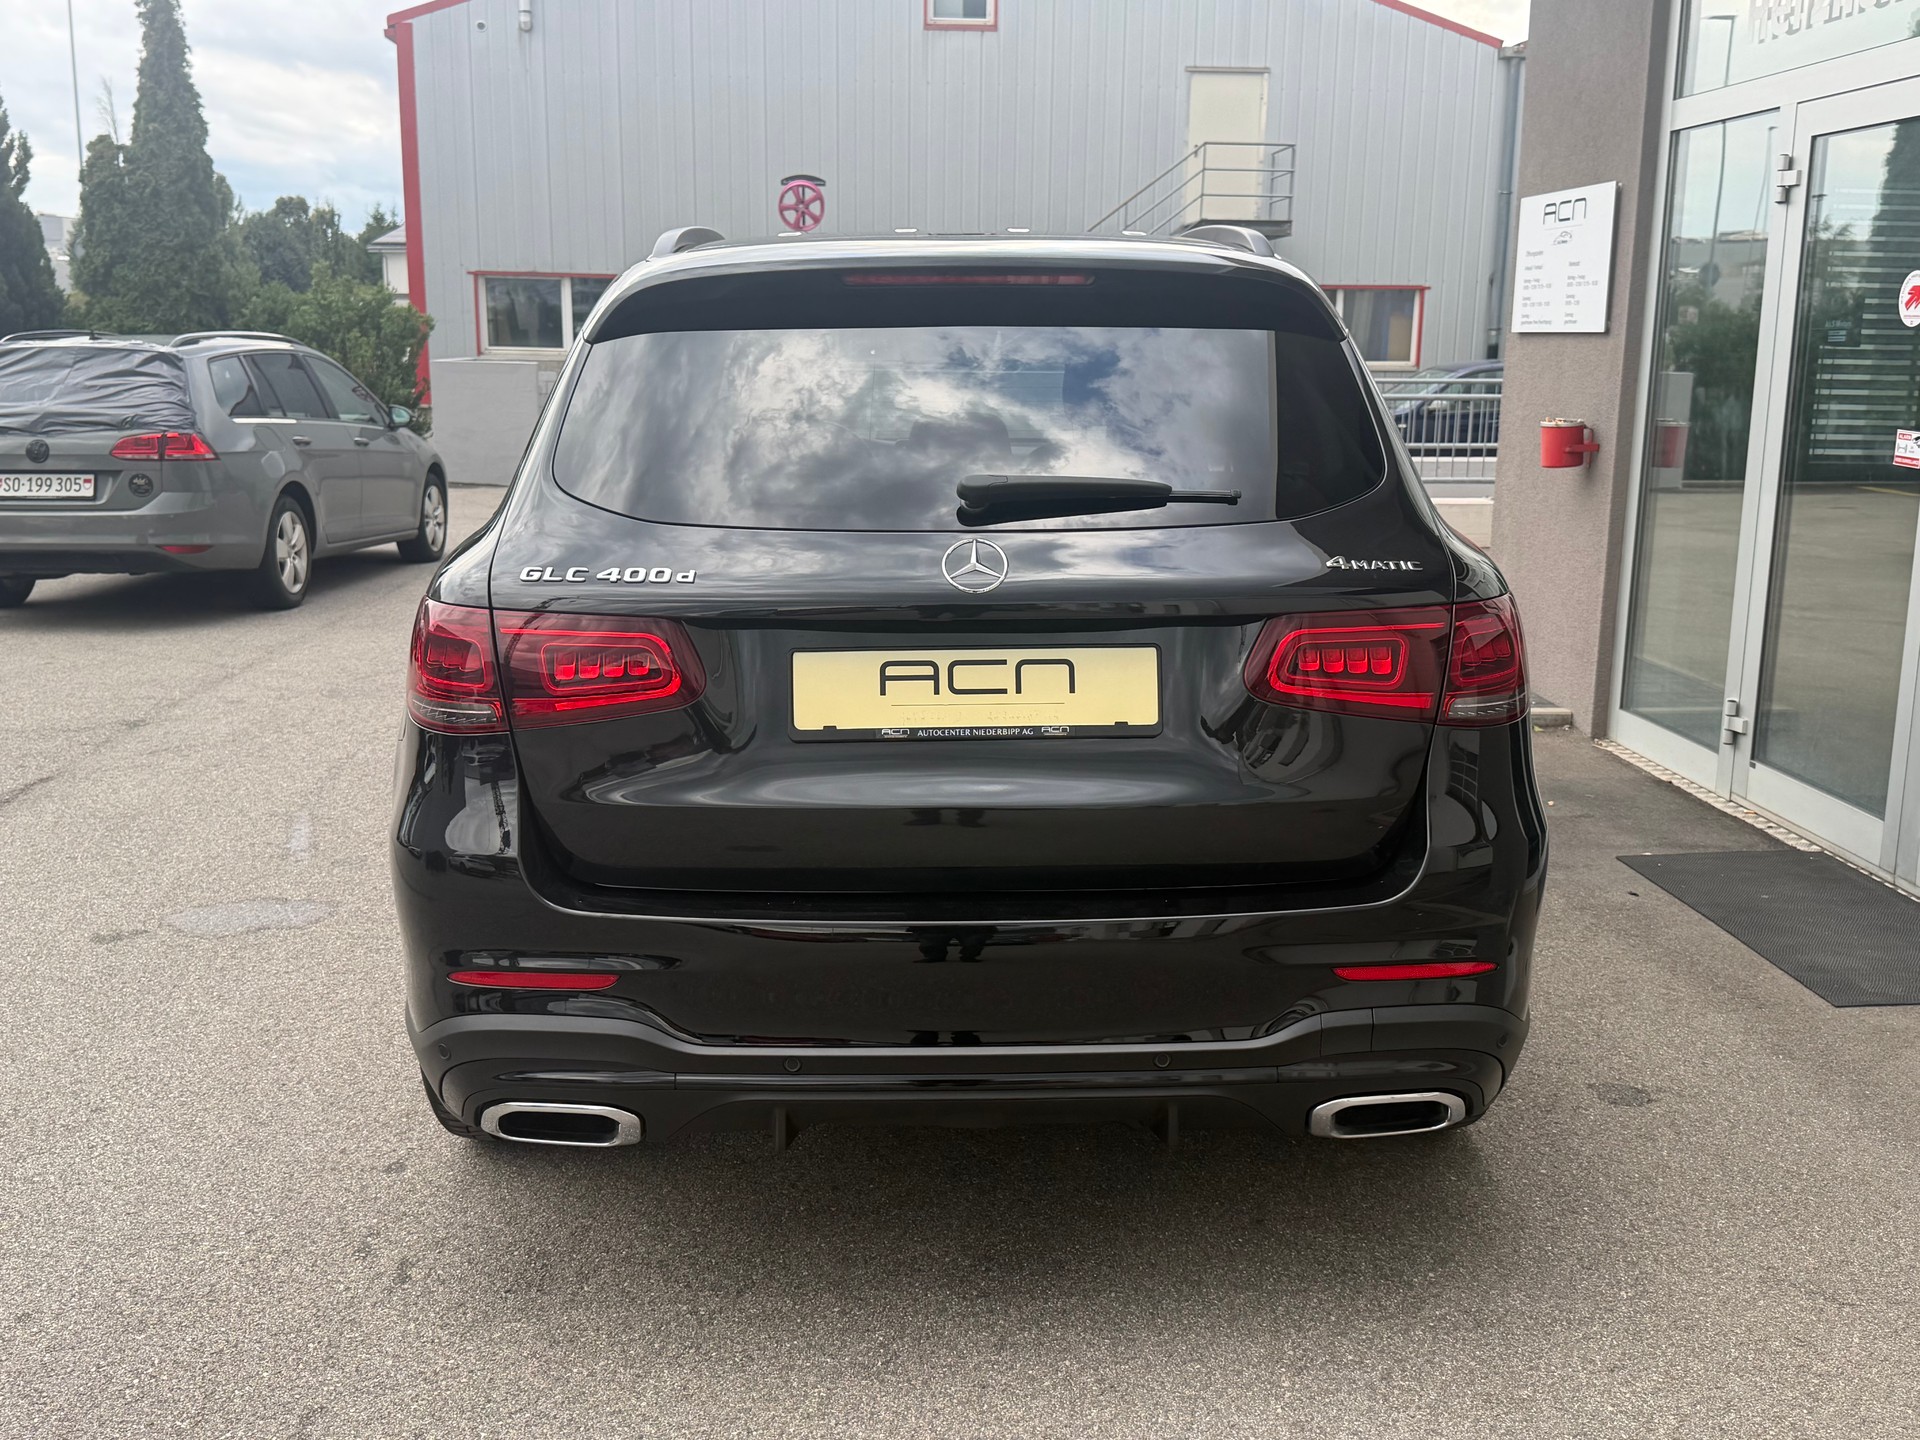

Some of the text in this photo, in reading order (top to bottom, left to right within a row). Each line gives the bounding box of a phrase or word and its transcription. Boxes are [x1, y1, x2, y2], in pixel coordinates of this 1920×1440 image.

[1325, 555, 1423, 571] 4MATIC
[519, 566, 589, 582] GLC
[917, 729, 971, 737] AUTOCENTER
[972, 728, 1020, 736] NIEDERBIPP
